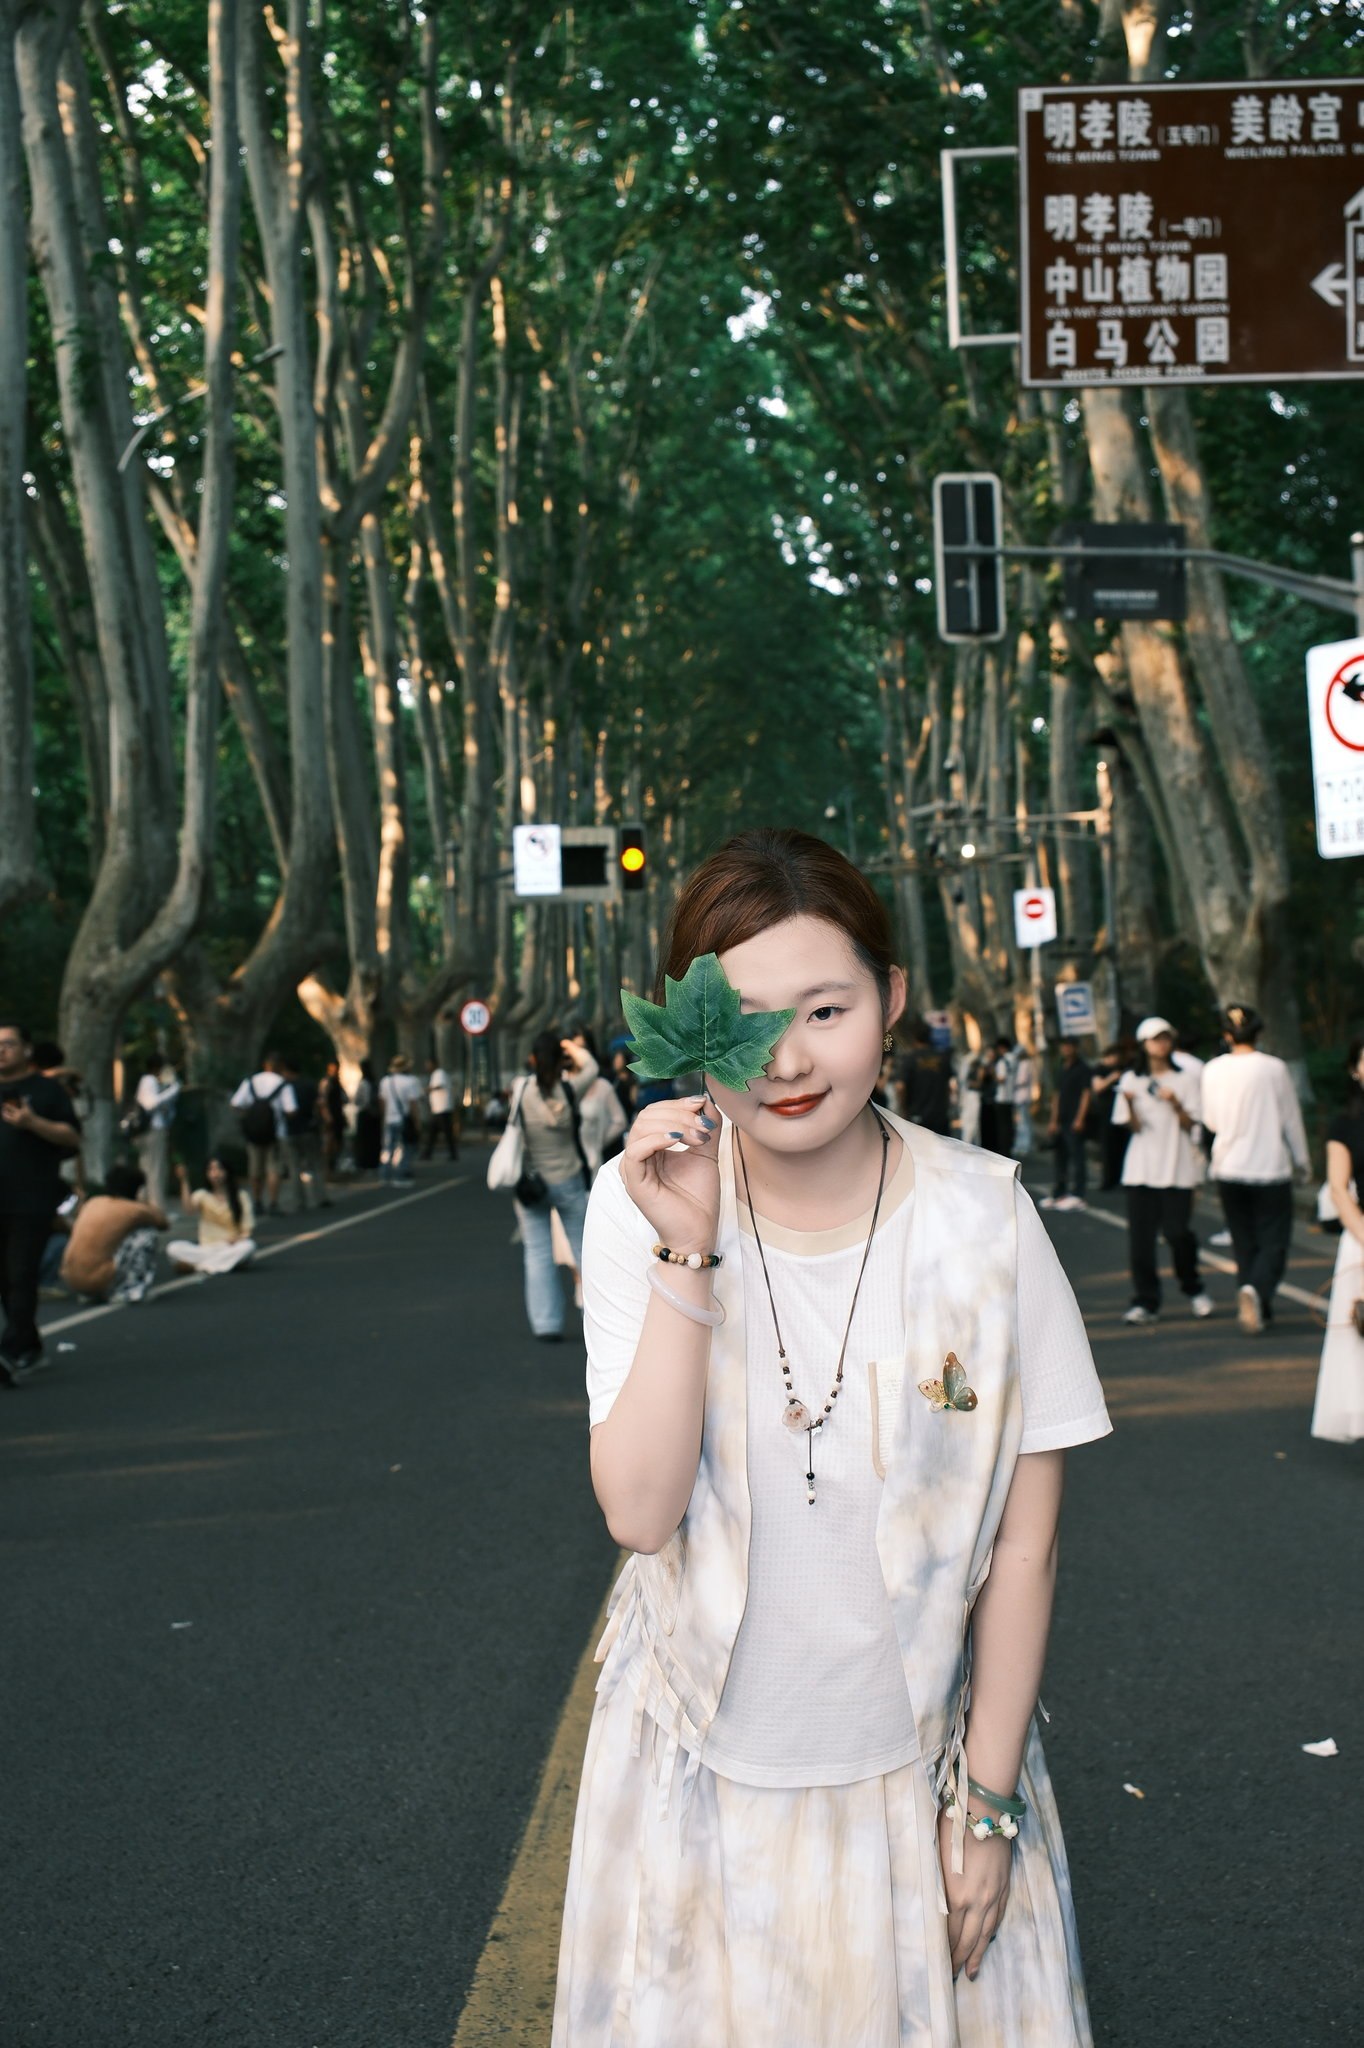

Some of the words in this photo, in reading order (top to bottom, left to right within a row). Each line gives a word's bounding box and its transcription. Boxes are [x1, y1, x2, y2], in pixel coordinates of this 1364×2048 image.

[1044, 98, 1153, 149] 明孝陵
[1230, 92, 1343, 145] 美龄宫
[1045, 151, 1073, 165] THE
[1044, 191, 1154, 242] 明孝陵
[1044, 252, 1229, 306] 中山植物园
[1046, 315, 1230, 368] 白马公园
